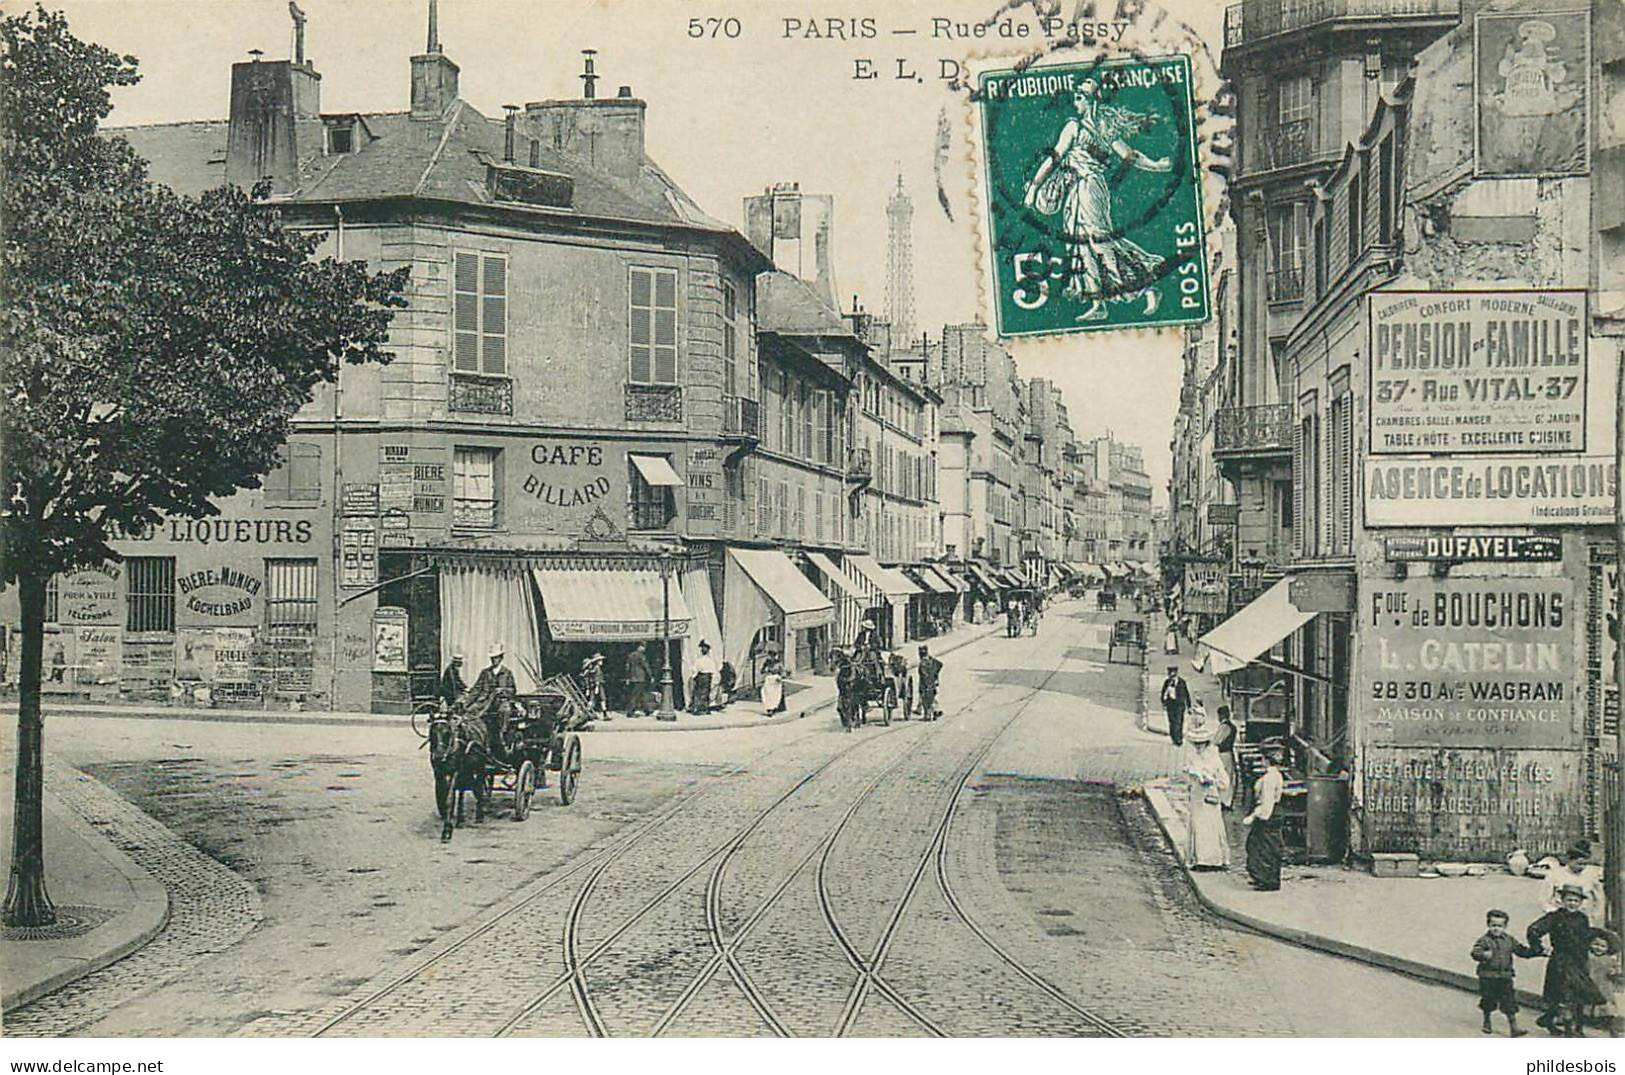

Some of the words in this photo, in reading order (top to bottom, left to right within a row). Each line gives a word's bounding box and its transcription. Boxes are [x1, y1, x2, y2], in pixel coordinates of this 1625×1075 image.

[1420, 298, 1471, 318] CONFORT
[1481, 299, 1537, 316] MODERNE
[1376, 321, 1471, 370] PENSION
[1486, 319, 1580, 368] FAMILLE
[1377, 379, 1409, 403] 37
[1464, 377, 1536, 400] VITAL
[1545, 376, 1578, 400] 37
[1384, 433, 1414, 446] TABLE
[1461, 432, 1523, 445] EXCELLENTE
[1529, 431, 1571, 444] CUISINE
[532, 443, 602, 466] CAFÉ
[523, 474, 610, 506] BILLARD
[689, 474, 712, 487] VINS
[1370, 467, 1463, 500] AGENCE
[1466, 472, 1481, 498] de
[170, 520, 312, 544] LIQUEURS
[1427, 537, 1518, 557] DUFAYEL
[221, 566, 261, 596] MUNICH
[1412, 599, 1429, 627] de
[1434, 592, 1563, 627] BOUCHONS
[1469, 682, 1563, 701] WAGRAM
[1378, 707, 1444, 721] MAISON
[1468, 707, 1560, 722] CONFIANCE
